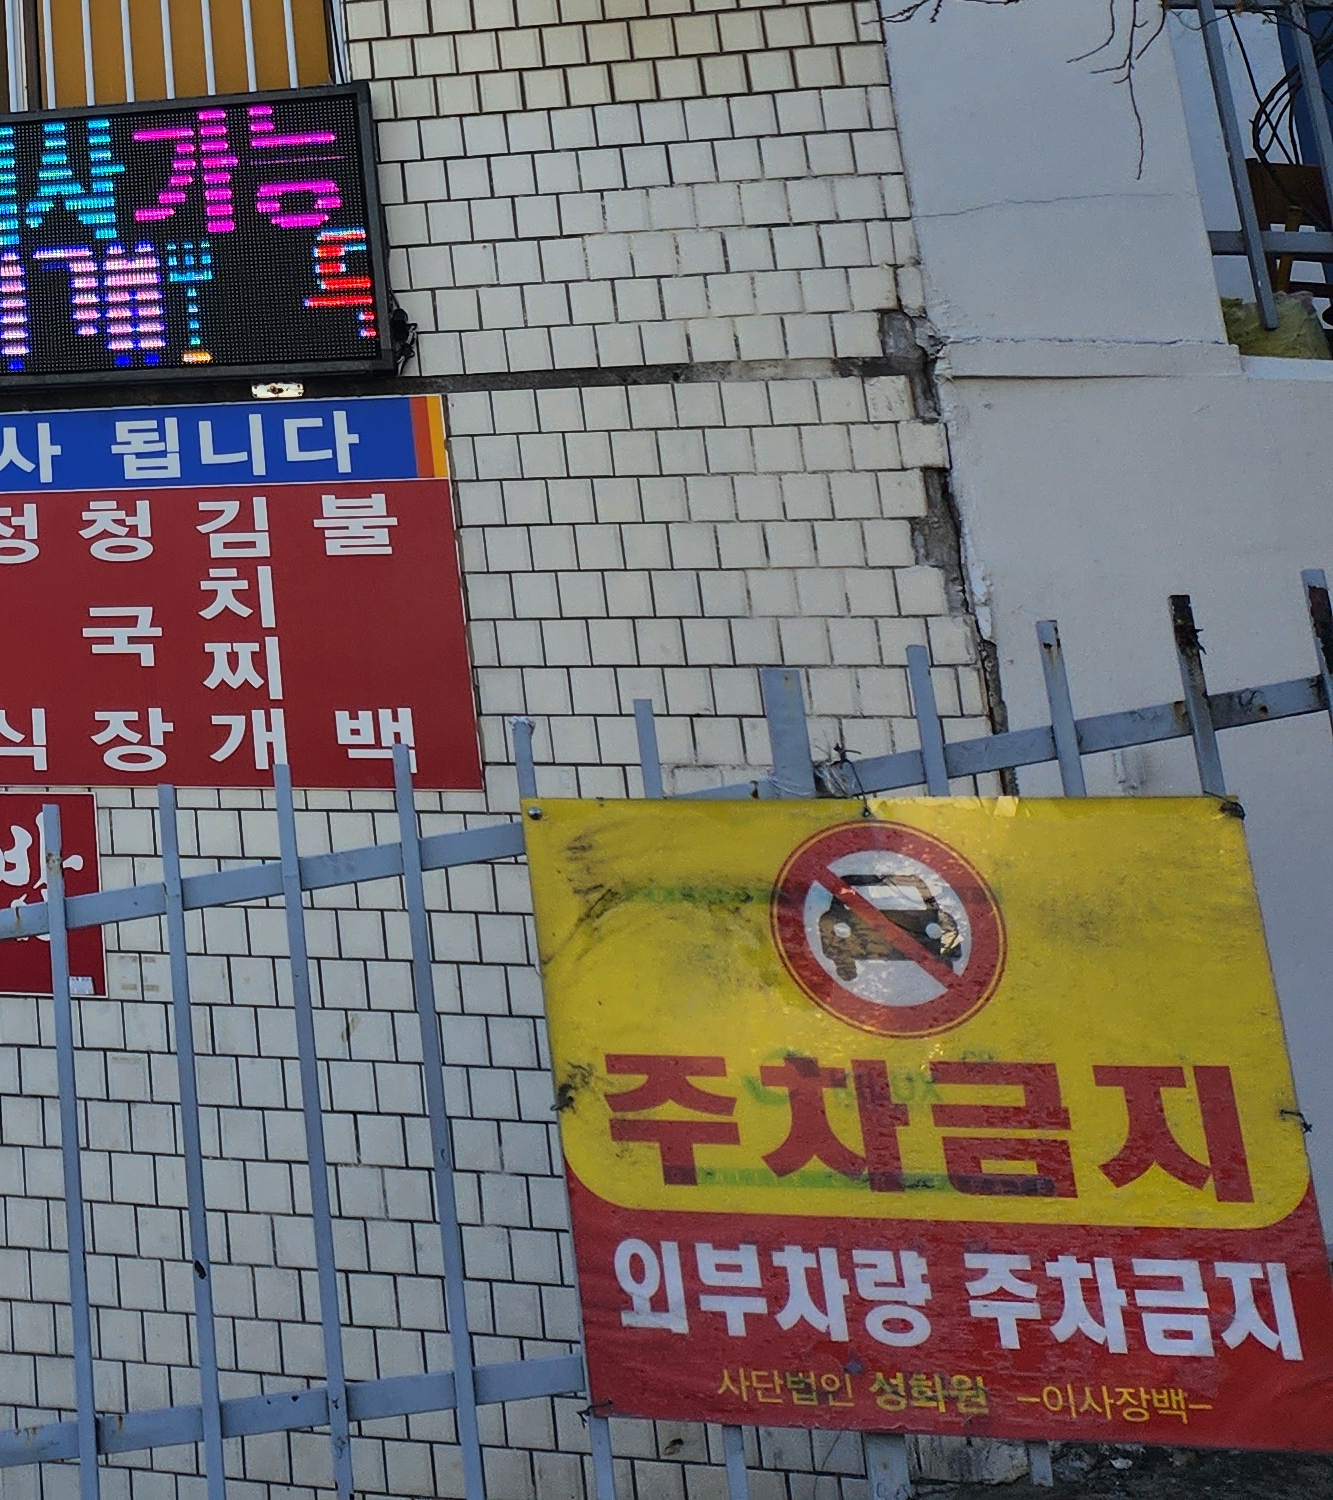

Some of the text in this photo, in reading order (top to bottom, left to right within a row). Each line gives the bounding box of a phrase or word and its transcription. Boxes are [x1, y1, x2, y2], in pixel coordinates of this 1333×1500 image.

[110, 414, 361, 480] 됩니다
[77, 499, 175, 773] 청국장
[195, 496, 290, 772] 김치찌개
[312, 492, 419, 774] 불백
[604, 1053, 1256, 1204] 주차금지
[613, 1236, 1305, 1362] 외부차량 주차금지
[717, 1367, 855, 1408] 사단법인
[869, 1371, 991, 1416] 성화원
